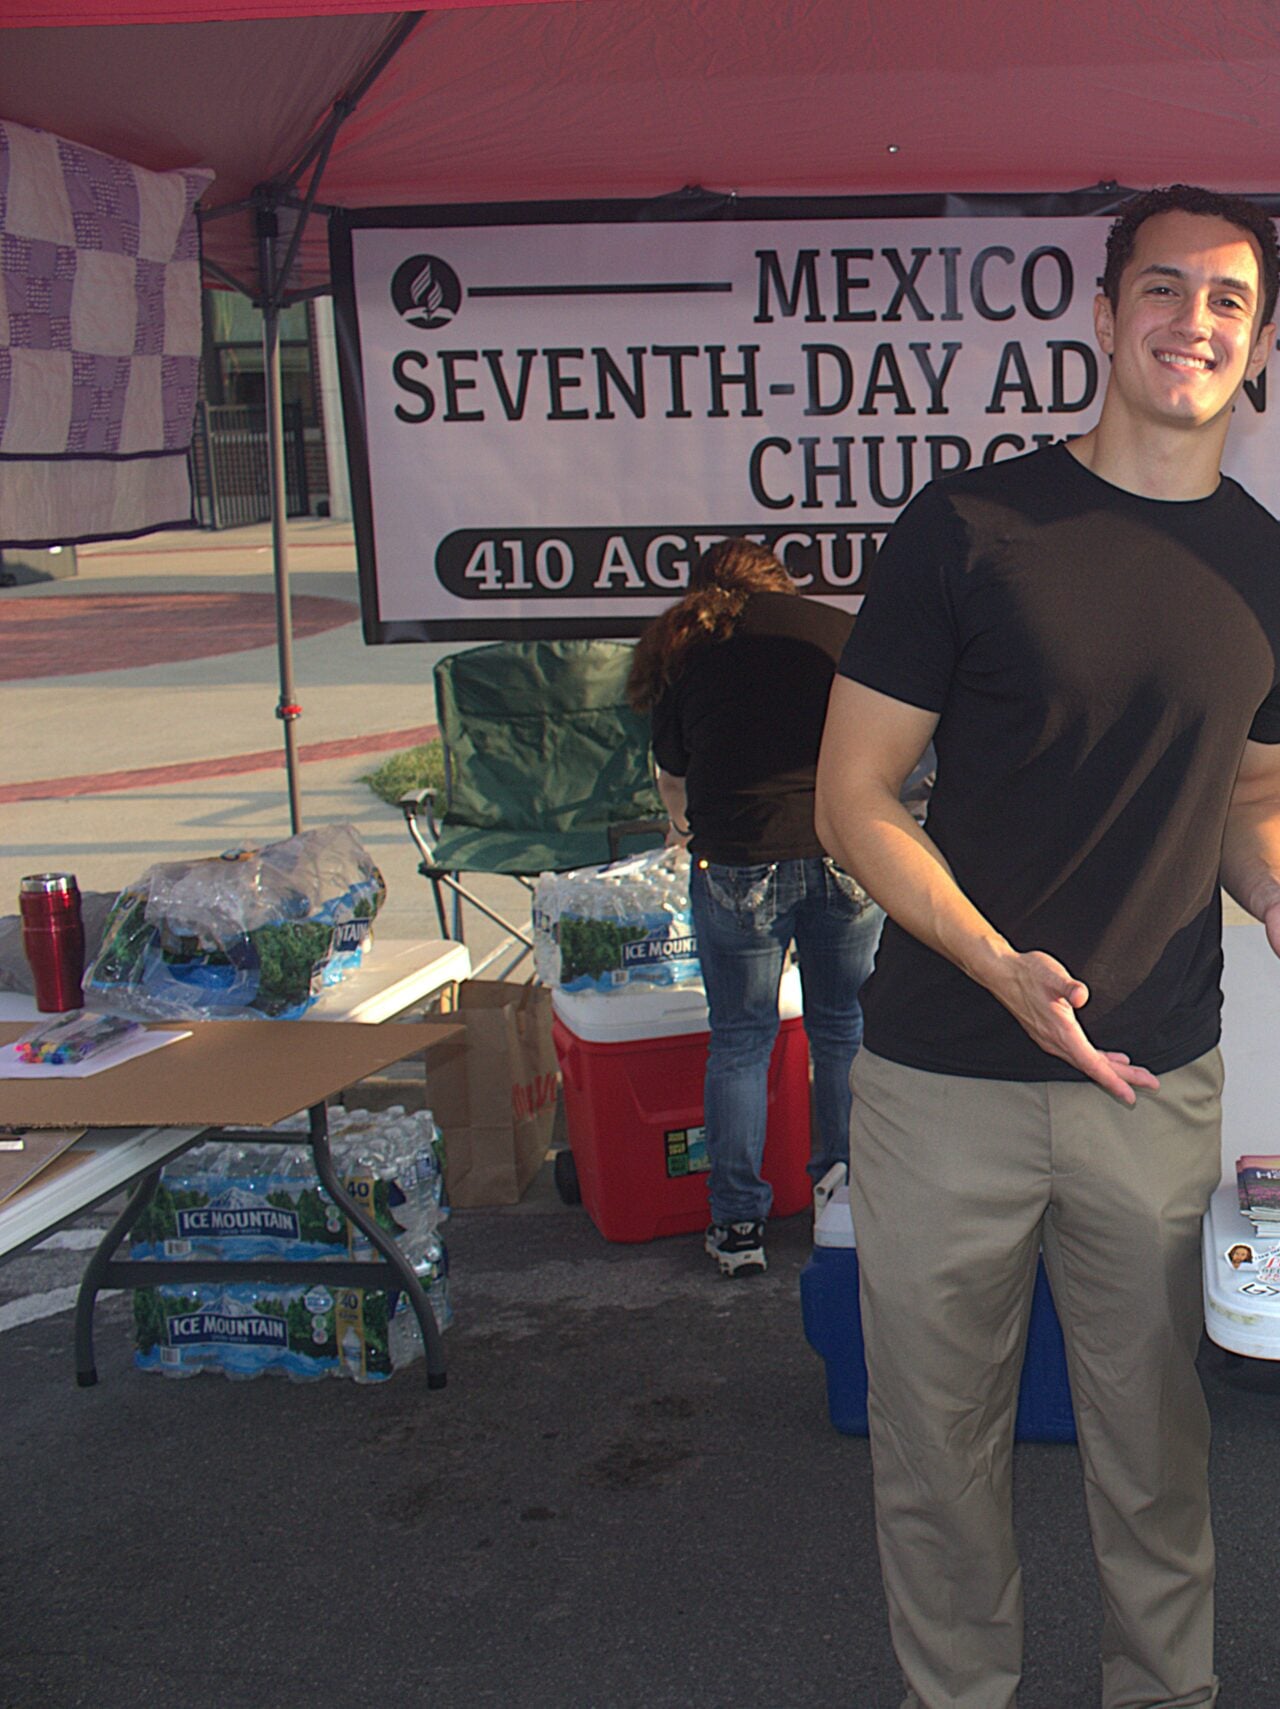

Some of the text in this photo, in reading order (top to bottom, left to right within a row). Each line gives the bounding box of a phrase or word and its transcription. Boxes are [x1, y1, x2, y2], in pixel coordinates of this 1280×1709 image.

[752, 245, 1074, 323] MEXICO
[392, 341, 963, 424] SEVENTH-DAY
[748, 433, 1083, 510] CHUR
[463, 538, 575, 591] 410
[625, 943, 646, 961] ICE
[183, 1210, 294, 1231] ICE MOUNTAIN
[173, 1319, 199, 1337] ICE
[203, 1315, 283, 1338] MOUNTAIN
